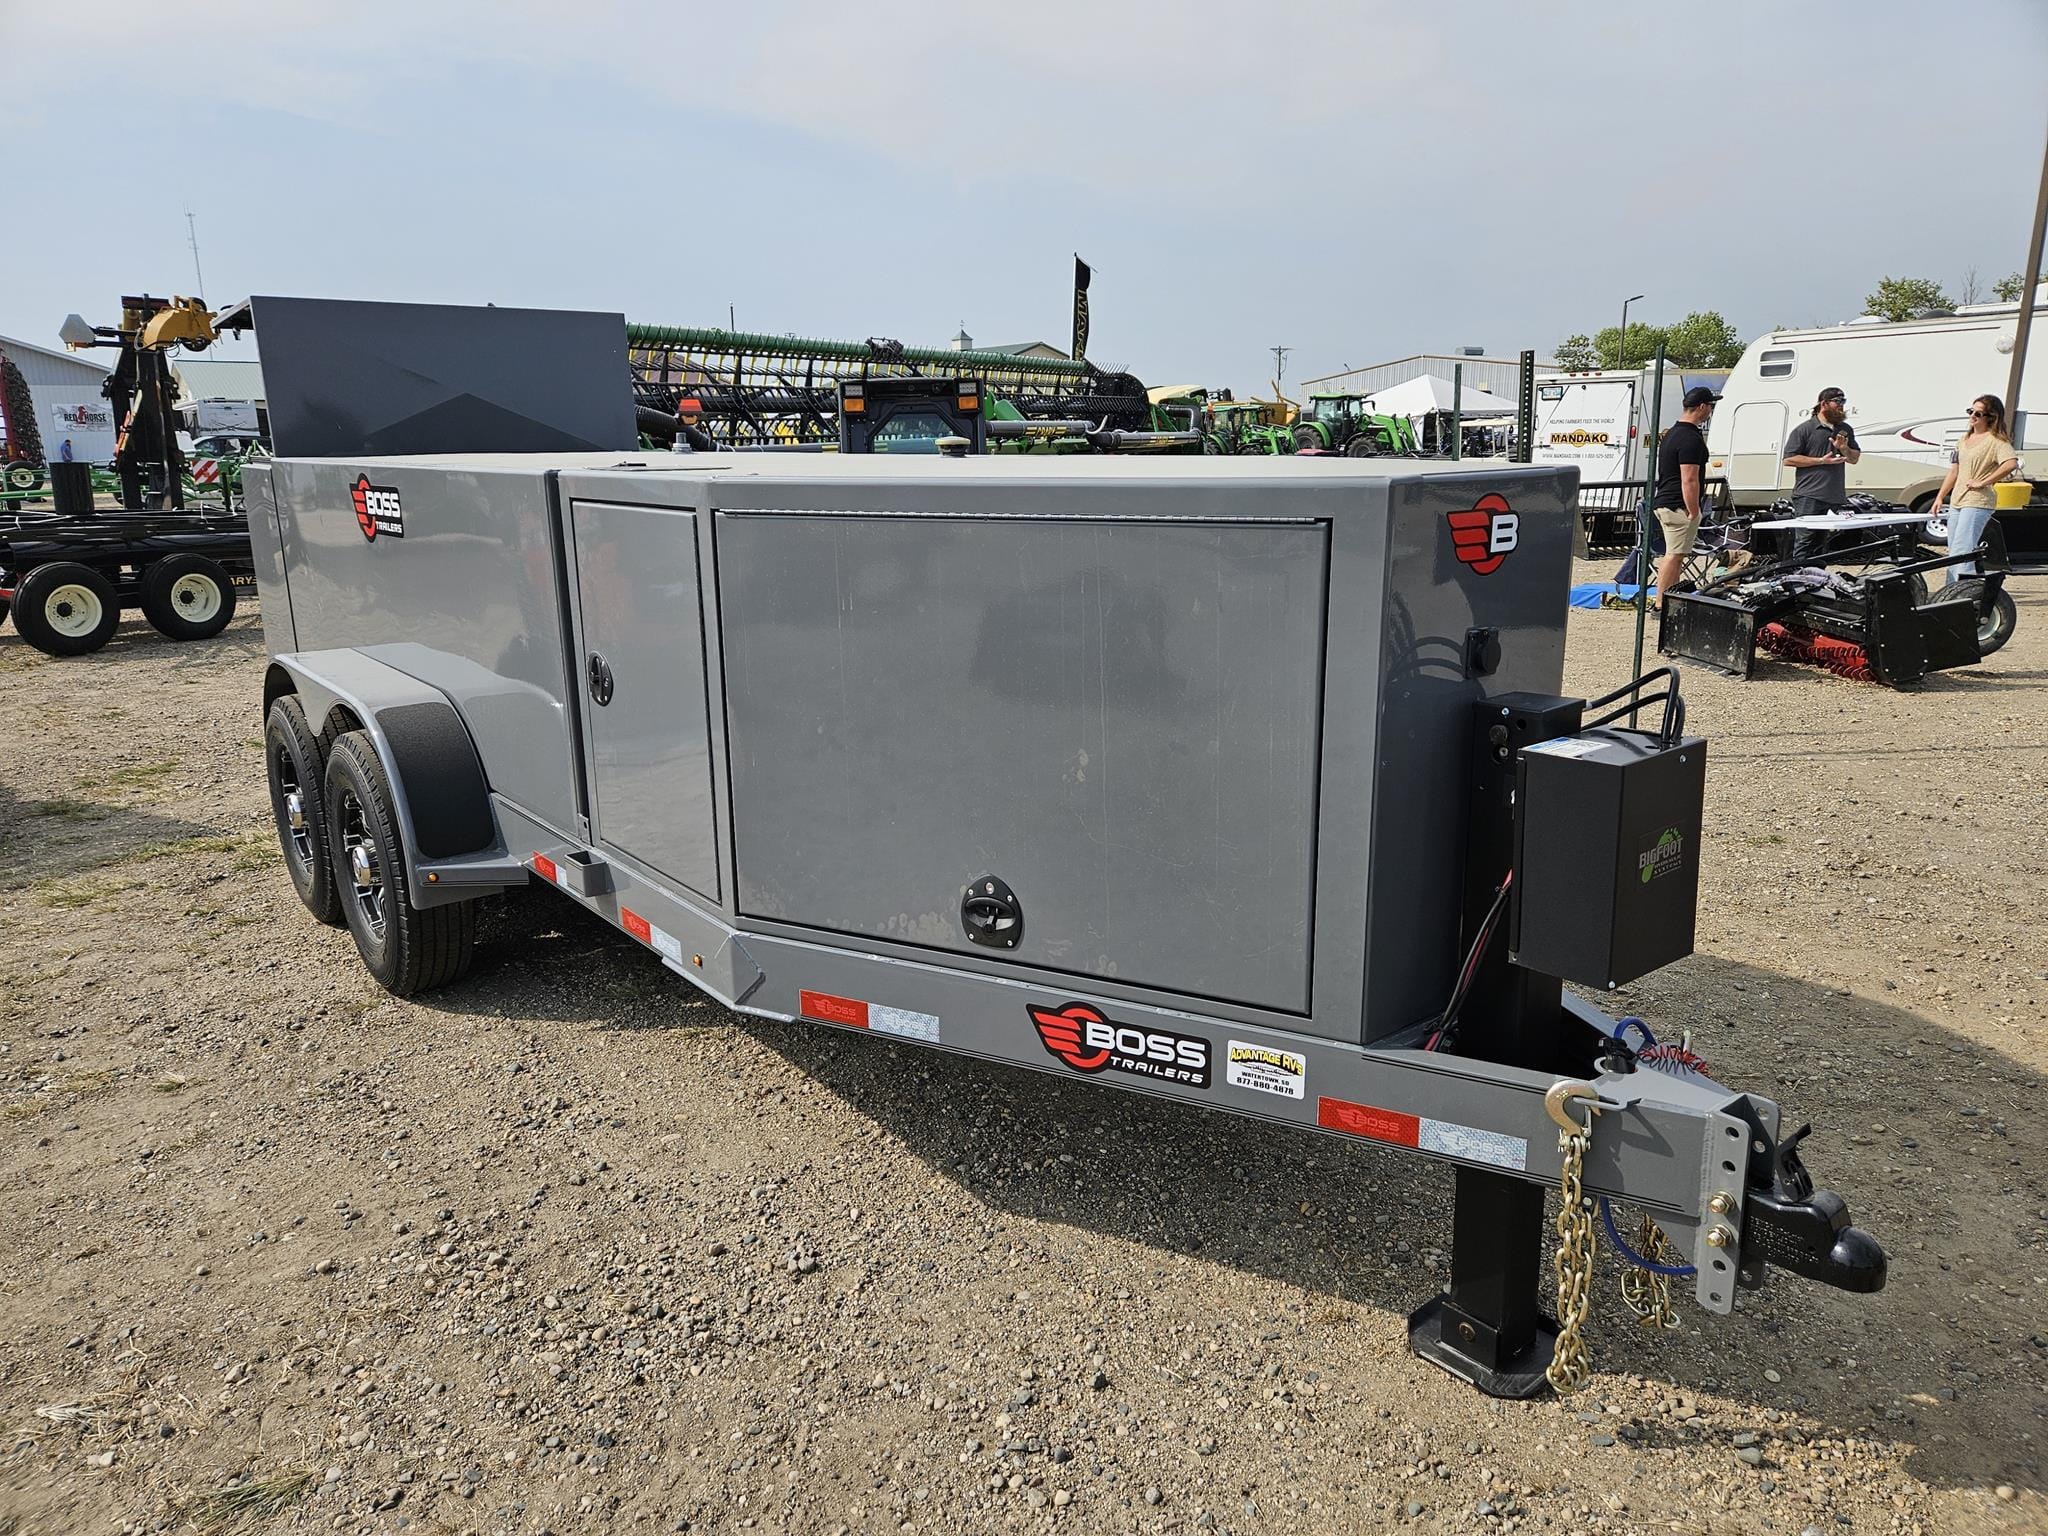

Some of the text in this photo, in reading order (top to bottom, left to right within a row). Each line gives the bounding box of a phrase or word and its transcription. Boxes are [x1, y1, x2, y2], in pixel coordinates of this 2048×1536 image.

[64, 413, 107, 422] RED HORSE
[1551, 434, 1608, 443] MANDAKO
[365, 490, 401, 518] BOSS
[375, 520, 403, 534] TRAILERS
[1490, 513, 1519, 553] B
[1639, 837, 1684, 869] BIGFOOT
[1086, 1021, 1206, 1069] BOSS
[1230, 1047, 1281, 1067] ADVANTAGE
[1110, 1056, 1204, 1084] TRAILERS
[1236, 1077, 1294, 1095] 877-880-4878
[1356, 1114, 1400, 1132] BOSS
